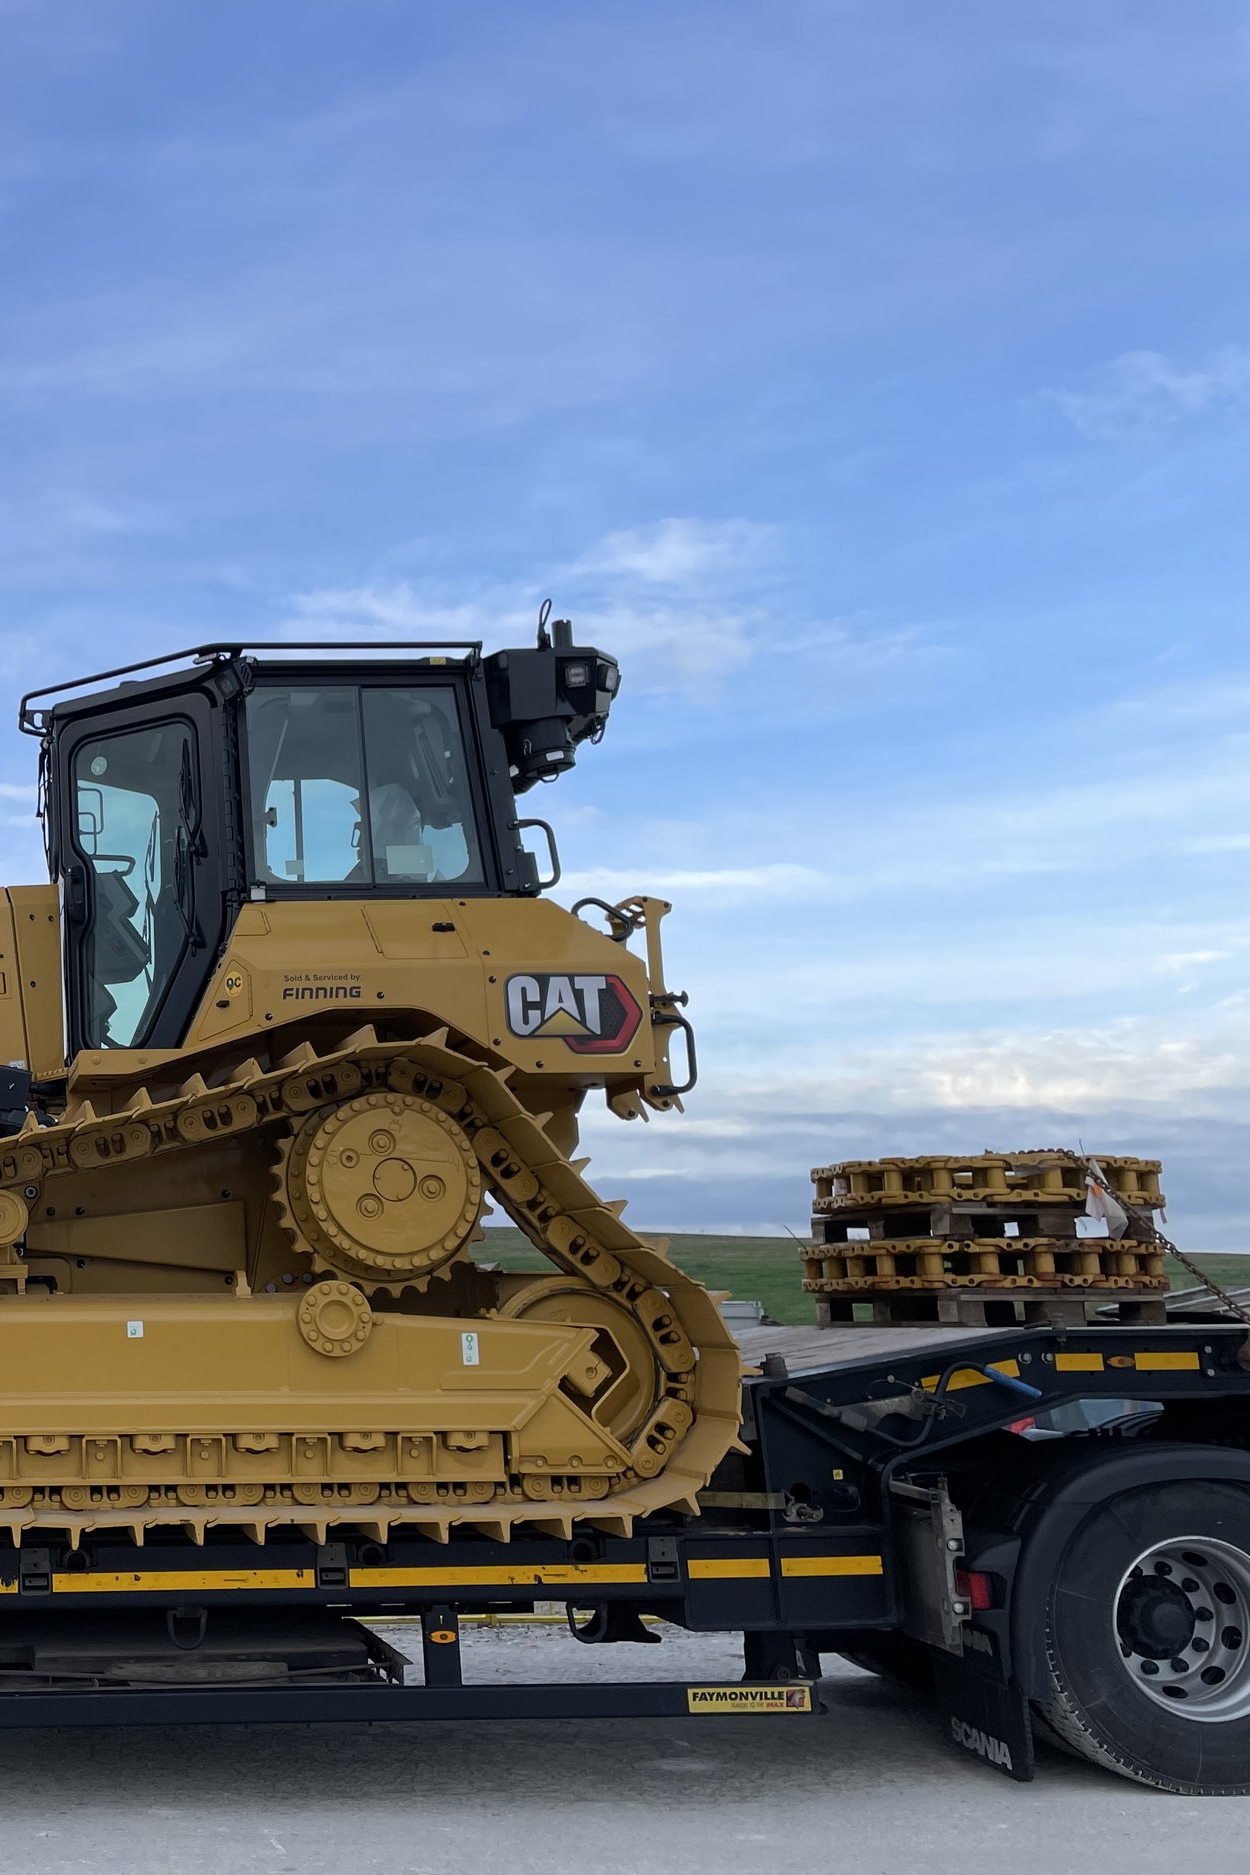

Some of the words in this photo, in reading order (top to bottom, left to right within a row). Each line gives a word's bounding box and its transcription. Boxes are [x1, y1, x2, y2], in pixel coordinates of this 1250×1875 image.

[284, 974, 303, 982] Sold
[304, 974, 311, 982] &
[312, 973, 348, 982] Serviced
[350, 973, 361, 982] by
[282, 985, 362, 1001] FINNING
[507, 975, 606, 1036] CAT
[692, 1690, 785, 1702] FAYMONVILLE
[951, 1716, 1013, 1771] SCANIA
